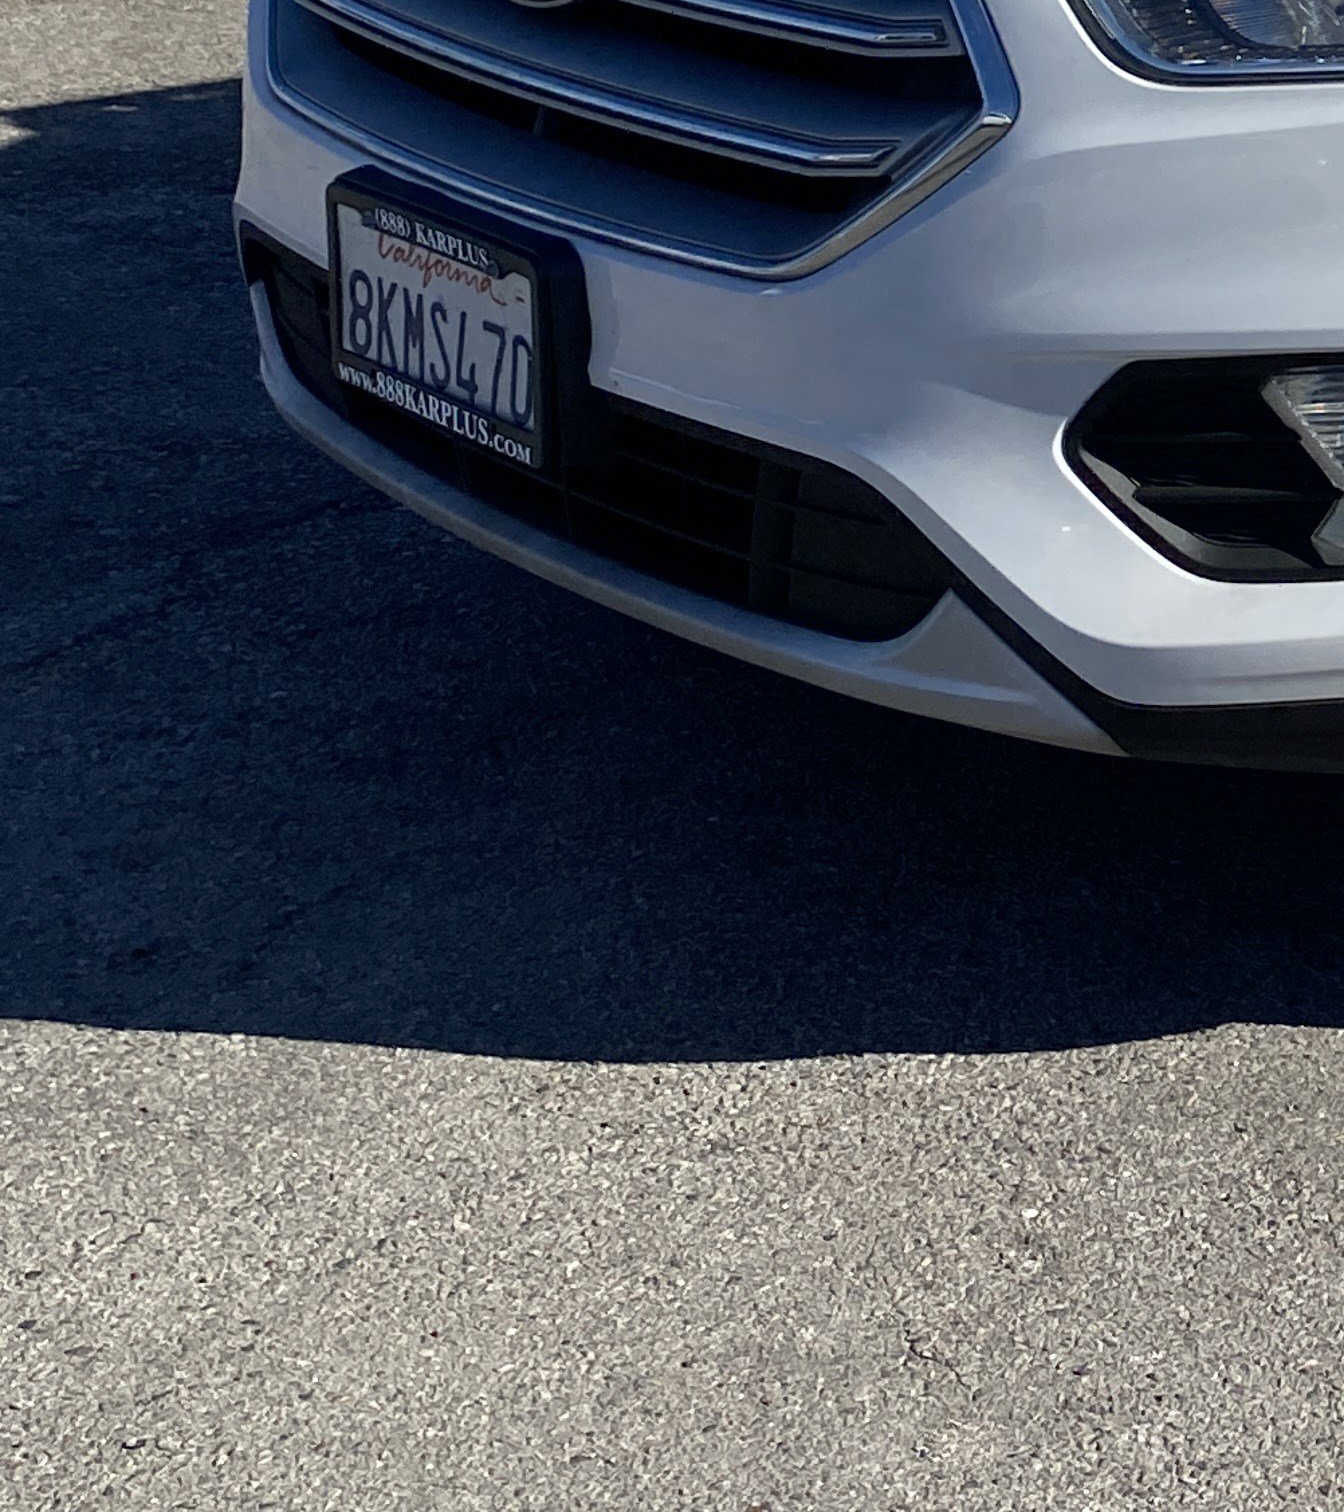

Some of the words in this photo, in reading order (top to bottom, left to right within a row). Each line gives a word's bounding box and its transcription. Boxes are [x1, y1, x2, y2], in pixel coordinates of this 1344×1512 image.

[374, 207, 411, 239] (888)
[415, 220, 490, 267] KARPLUS
[349, 268, 534, 425] 8KMS470
